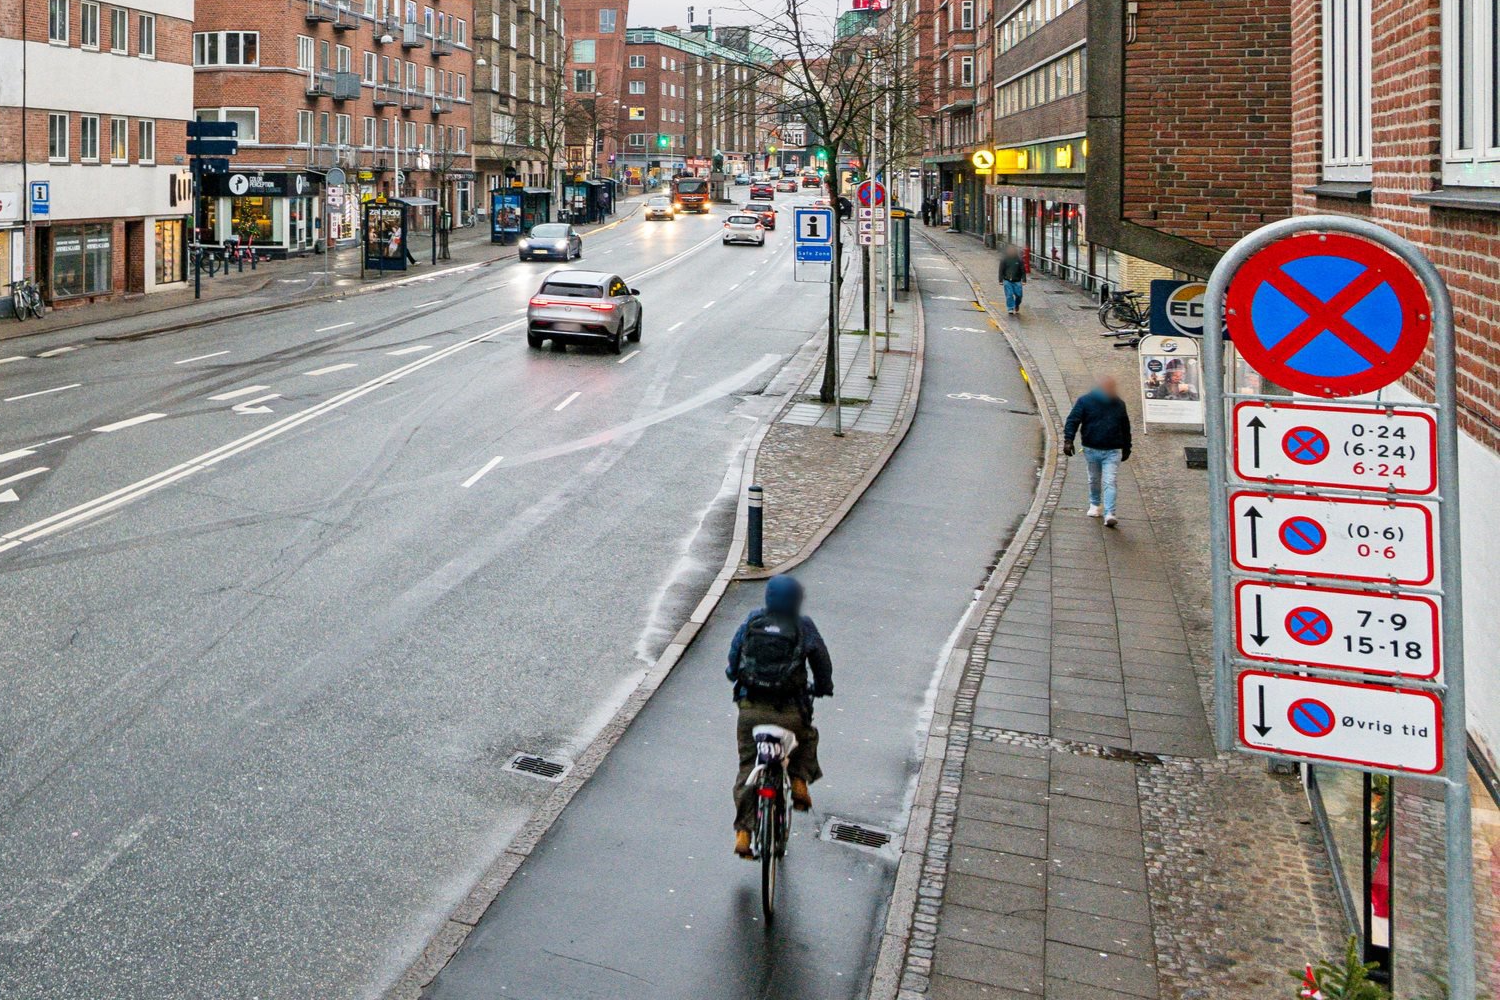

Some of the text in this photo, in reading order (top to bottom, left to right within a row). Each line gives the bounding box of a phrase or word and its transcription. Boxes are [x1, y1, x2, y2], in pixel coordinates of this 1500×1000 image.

[1170, 302, 1226, 318] ED
[1351, 424, 1406, 440] 0-24
[1343, 441, 1415, 460] (6-24)
[1352, 462, 1406, 478] 6-24
[1348, 523, 1404, 542] (0-6)
[1357, 544, 1396, 559] 0-6
[1357, 610, 1407, 631] 7-9
[1343, 635, 1422, 660] 15-18
[1341, 716, 1428, 738] Øvrig tid
